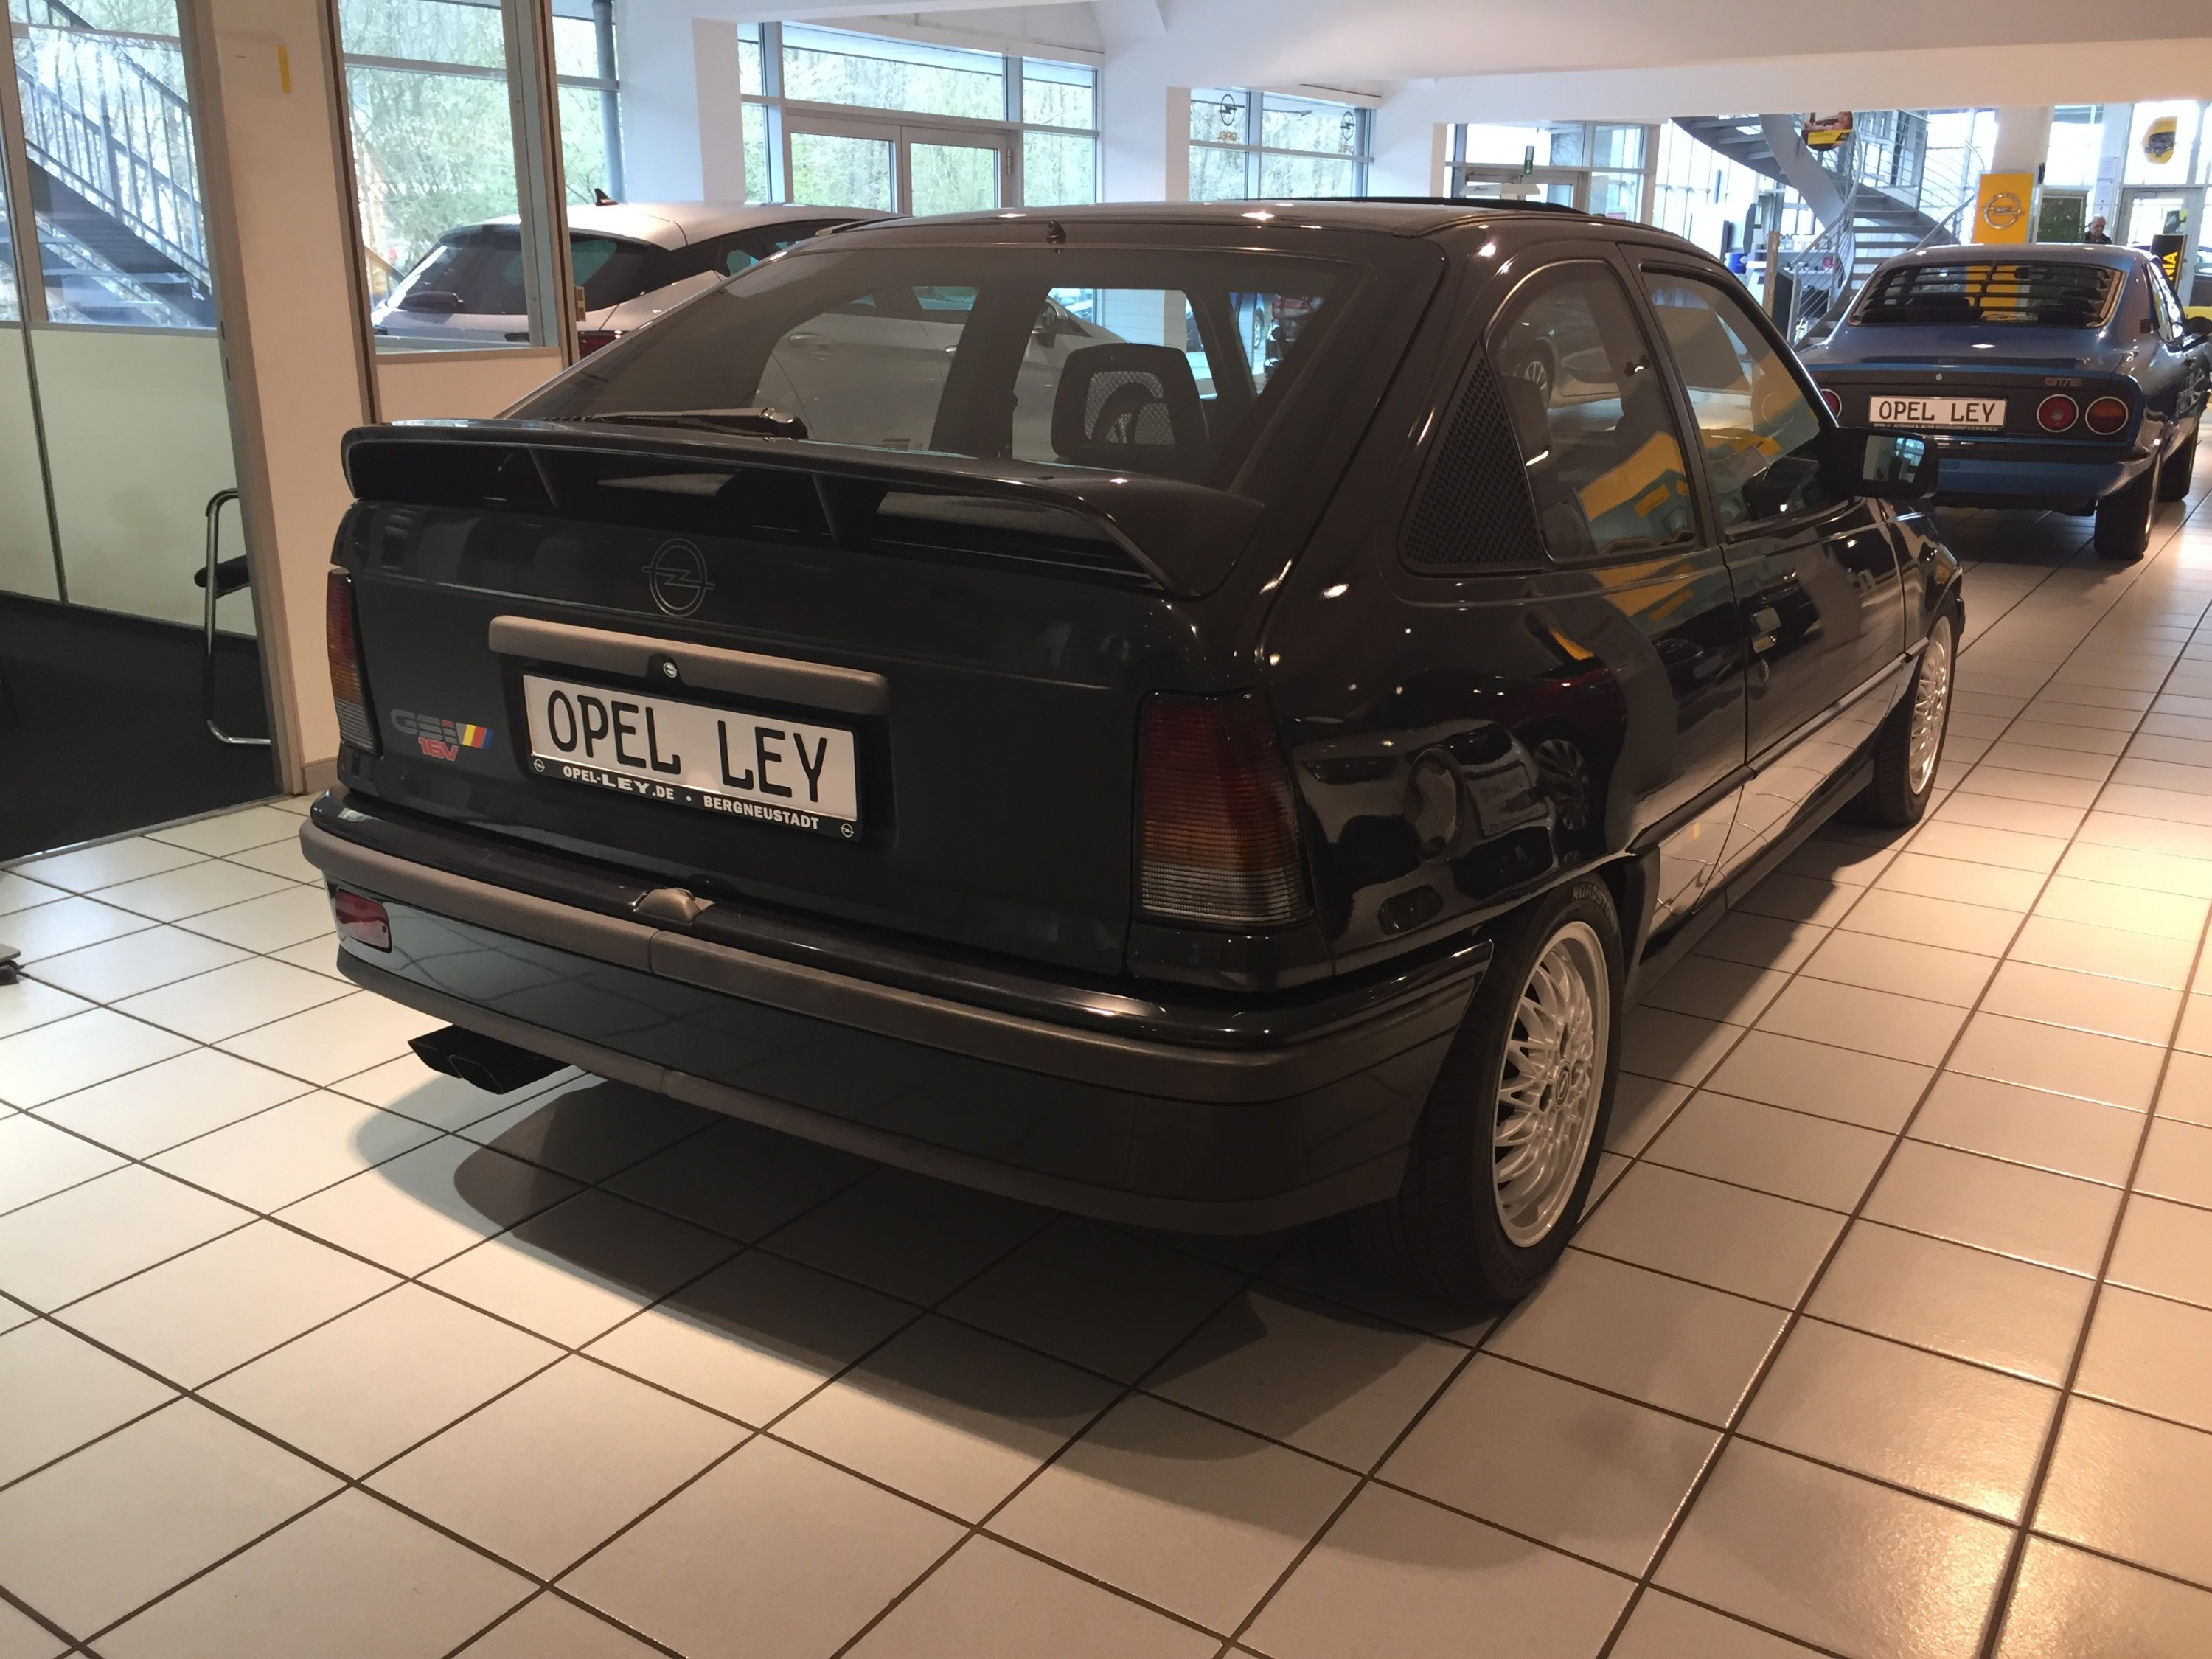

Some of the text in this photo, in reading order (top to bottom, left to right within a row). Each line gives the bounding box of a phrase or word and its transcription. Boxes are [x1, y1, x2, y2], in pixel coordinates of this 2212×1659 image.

[1879, 400, 1996, 422] OPEL LEY
[418, 737, 459, 762] 16V
[547, 690, 827, 803] OPEL LEY
[703, 795, 820, 830] BERGNEUSTADT
